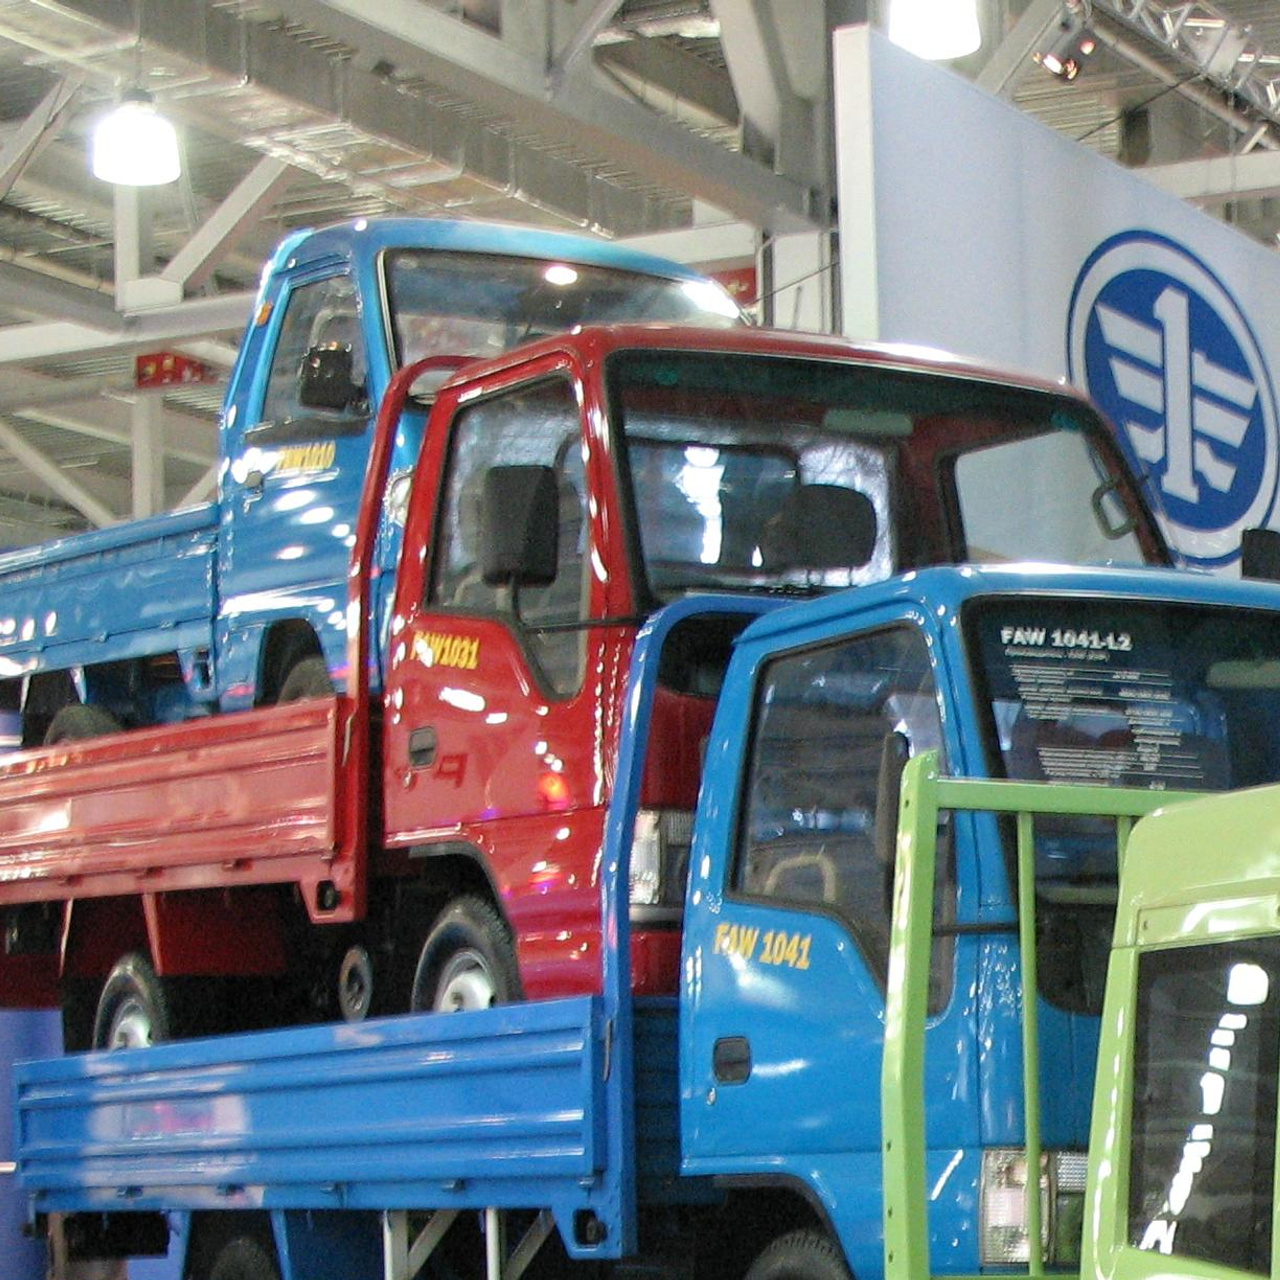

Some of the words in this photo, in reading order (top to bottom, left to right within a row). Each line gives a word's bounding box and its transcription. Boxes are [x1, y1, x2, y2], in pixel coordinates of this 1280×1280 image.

[1001, 626, 1046, 646] FAW
[713, 922, 760, 960] FAW
[759, 929, 812, 971] 1041
